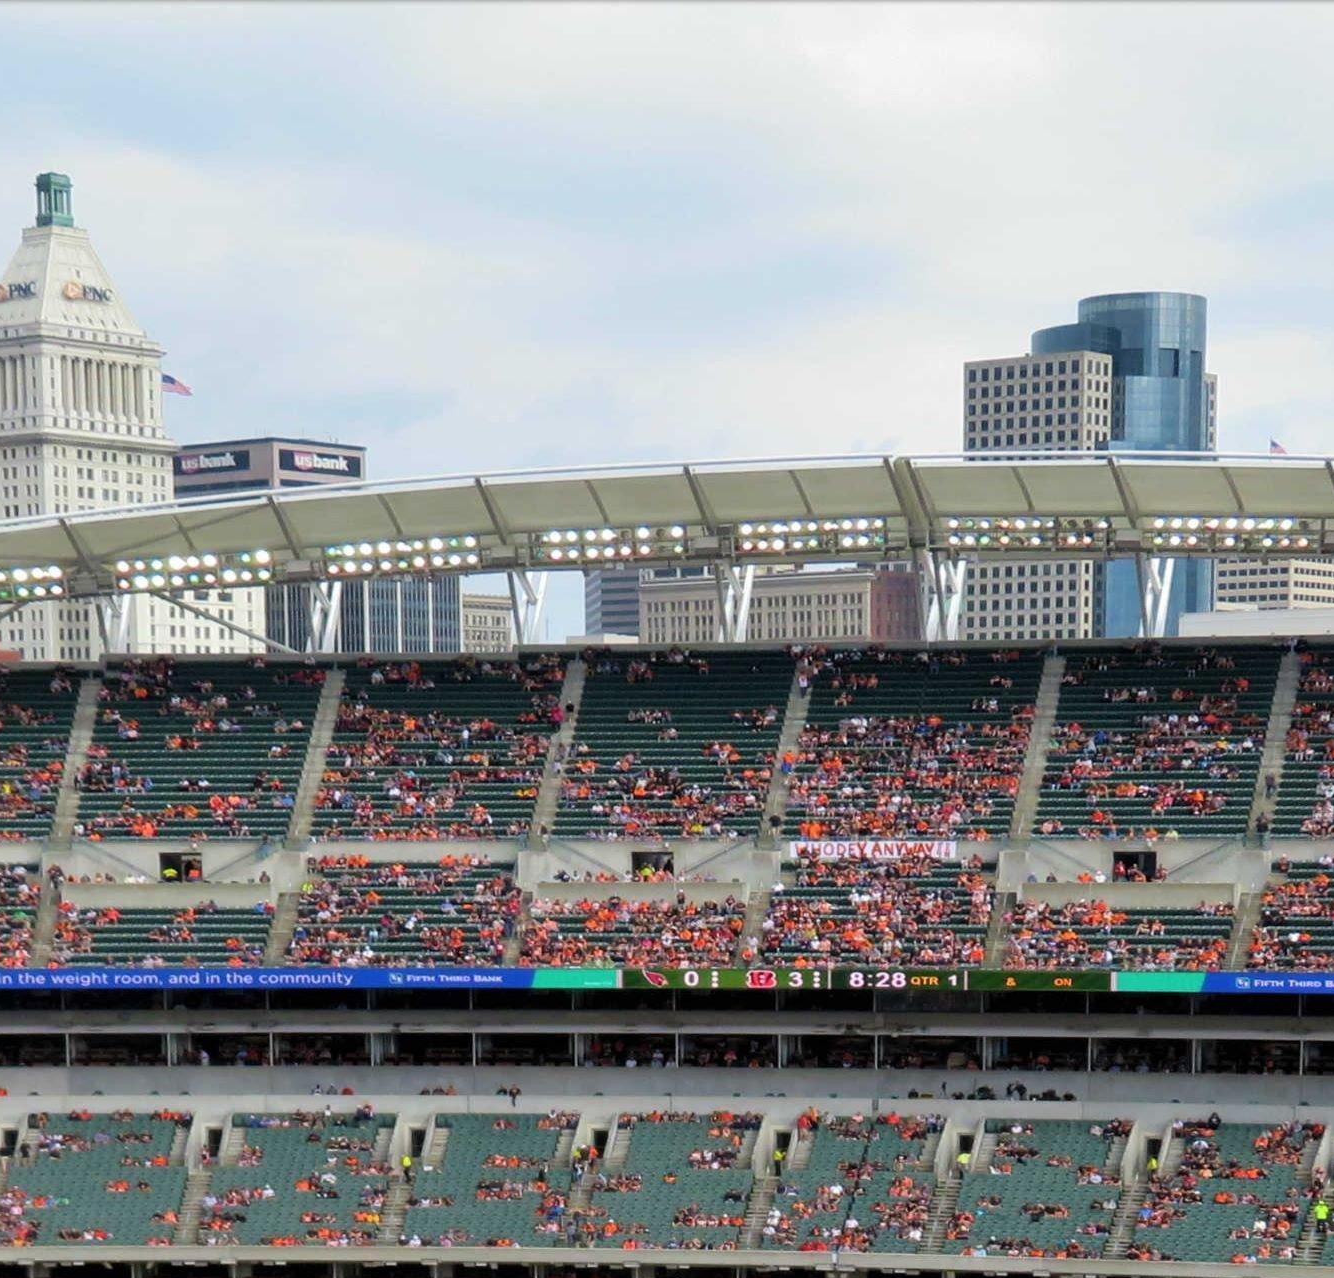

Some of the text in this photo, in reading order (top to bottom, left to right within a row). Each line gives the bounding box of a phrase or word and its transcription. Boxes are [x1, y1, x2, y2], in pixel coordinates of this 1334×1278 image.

[18, 972, 46, 985] the
[50, 972, 109, 988] weight
[114, 974, 164, 986] room,
[168, 972, 200, 985] and
[206, 972, 221, 985] in
[226, 972, 253, 985] the
[258, 972, 354, 987] community
[406, 974, 503, 983] FIFTH THIRD BANK
[684, 971, 698, 986] 0
[789, 972, 803, 986] 3
[848, 972, 958, 988] 8:28 QTR 1
[1053, 977, 1072, 987] ON
[1254, 979, 1284, 988] FIFTH
[1288, 979, 1322, 988] THIRD
